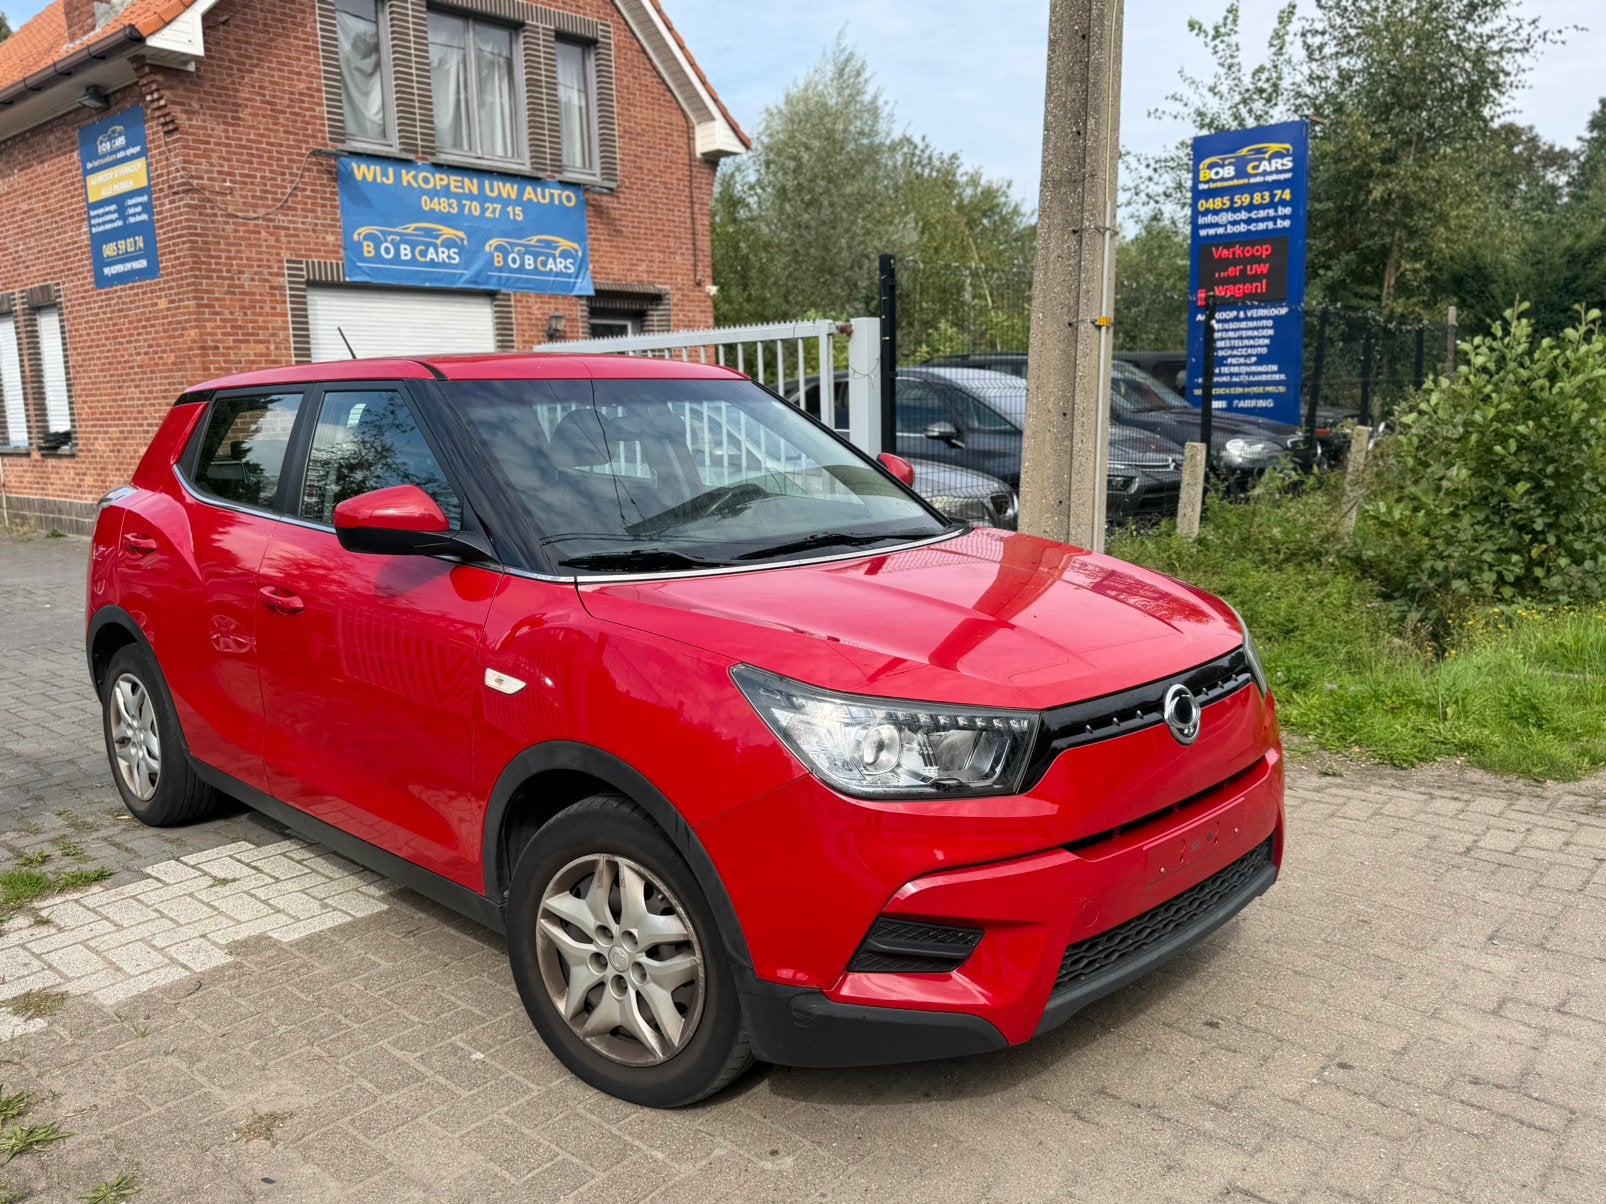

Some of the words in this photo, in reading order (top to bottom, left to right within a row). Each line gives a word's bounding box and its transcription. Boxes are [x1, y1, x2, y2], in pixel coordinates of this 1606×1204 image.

[1199, 166, 1235, 182] BOB
[1247, 157, 1293, 174] CARS
[352, 163, 394, 184] WIJ
[401, 169, 479, 195] KOPEN
[485, 181, 518, 199] UW
[523, 186, 576, 207] AUTO
[421, 196, 458, 214] 0483
[463, 201, 480, 216] 70
[485, 203, 502, 218] 27
[507, 205, 523, 221] 15
[1198, 197, 1230, 211] 0485
[1234, 194, 1250, 207] 59
[1253, 192, 1270, 204] 83
[1274, 189, 1291, 202] 74
[1198, 206, 1292, 224] info@bob-cars.be
[1199, 219, 1291, 236] www.bob-cars.be
[1212, 244, 1272, 259] Verkoop
[1247, 263, 1270, 275] uw
[1215, 279, 1267, 298] wagen!
[1247, 307, 1289, 318] VERKOOP
